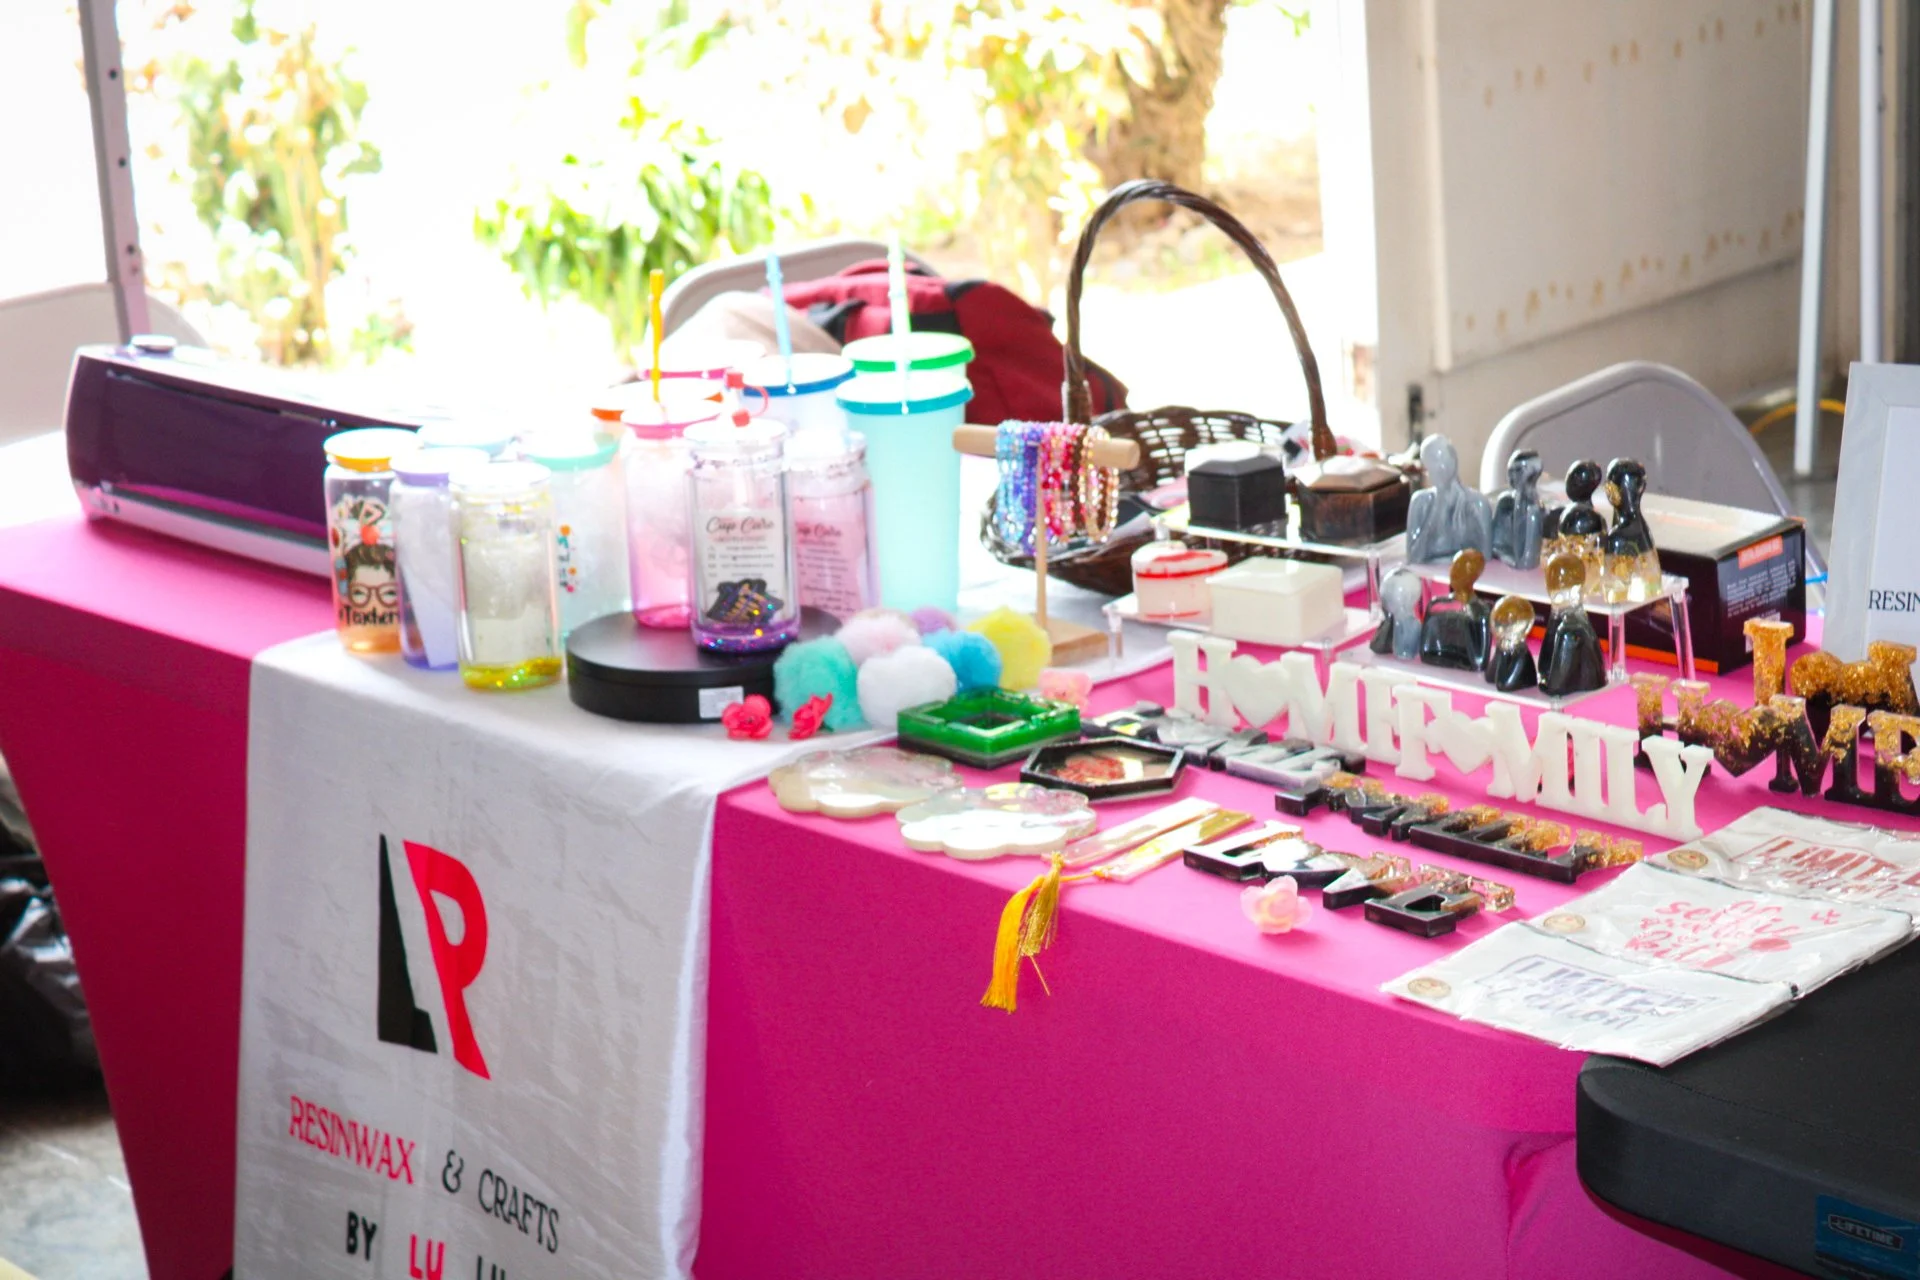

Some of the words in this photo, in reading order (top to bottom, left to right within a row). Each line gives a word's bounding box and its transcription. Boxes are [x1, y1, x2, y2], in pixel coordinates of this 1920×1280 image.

[706, 516, 737, 534] Cup
[289, 1095, 416, 1185] RESINWAX
[441, 1149, 464, 1194] &
[478, 1169, 560, 1254] CRAFTS
[345, 1210, 378, 1262] BY
[408, 1233, 445, 1280] LU
